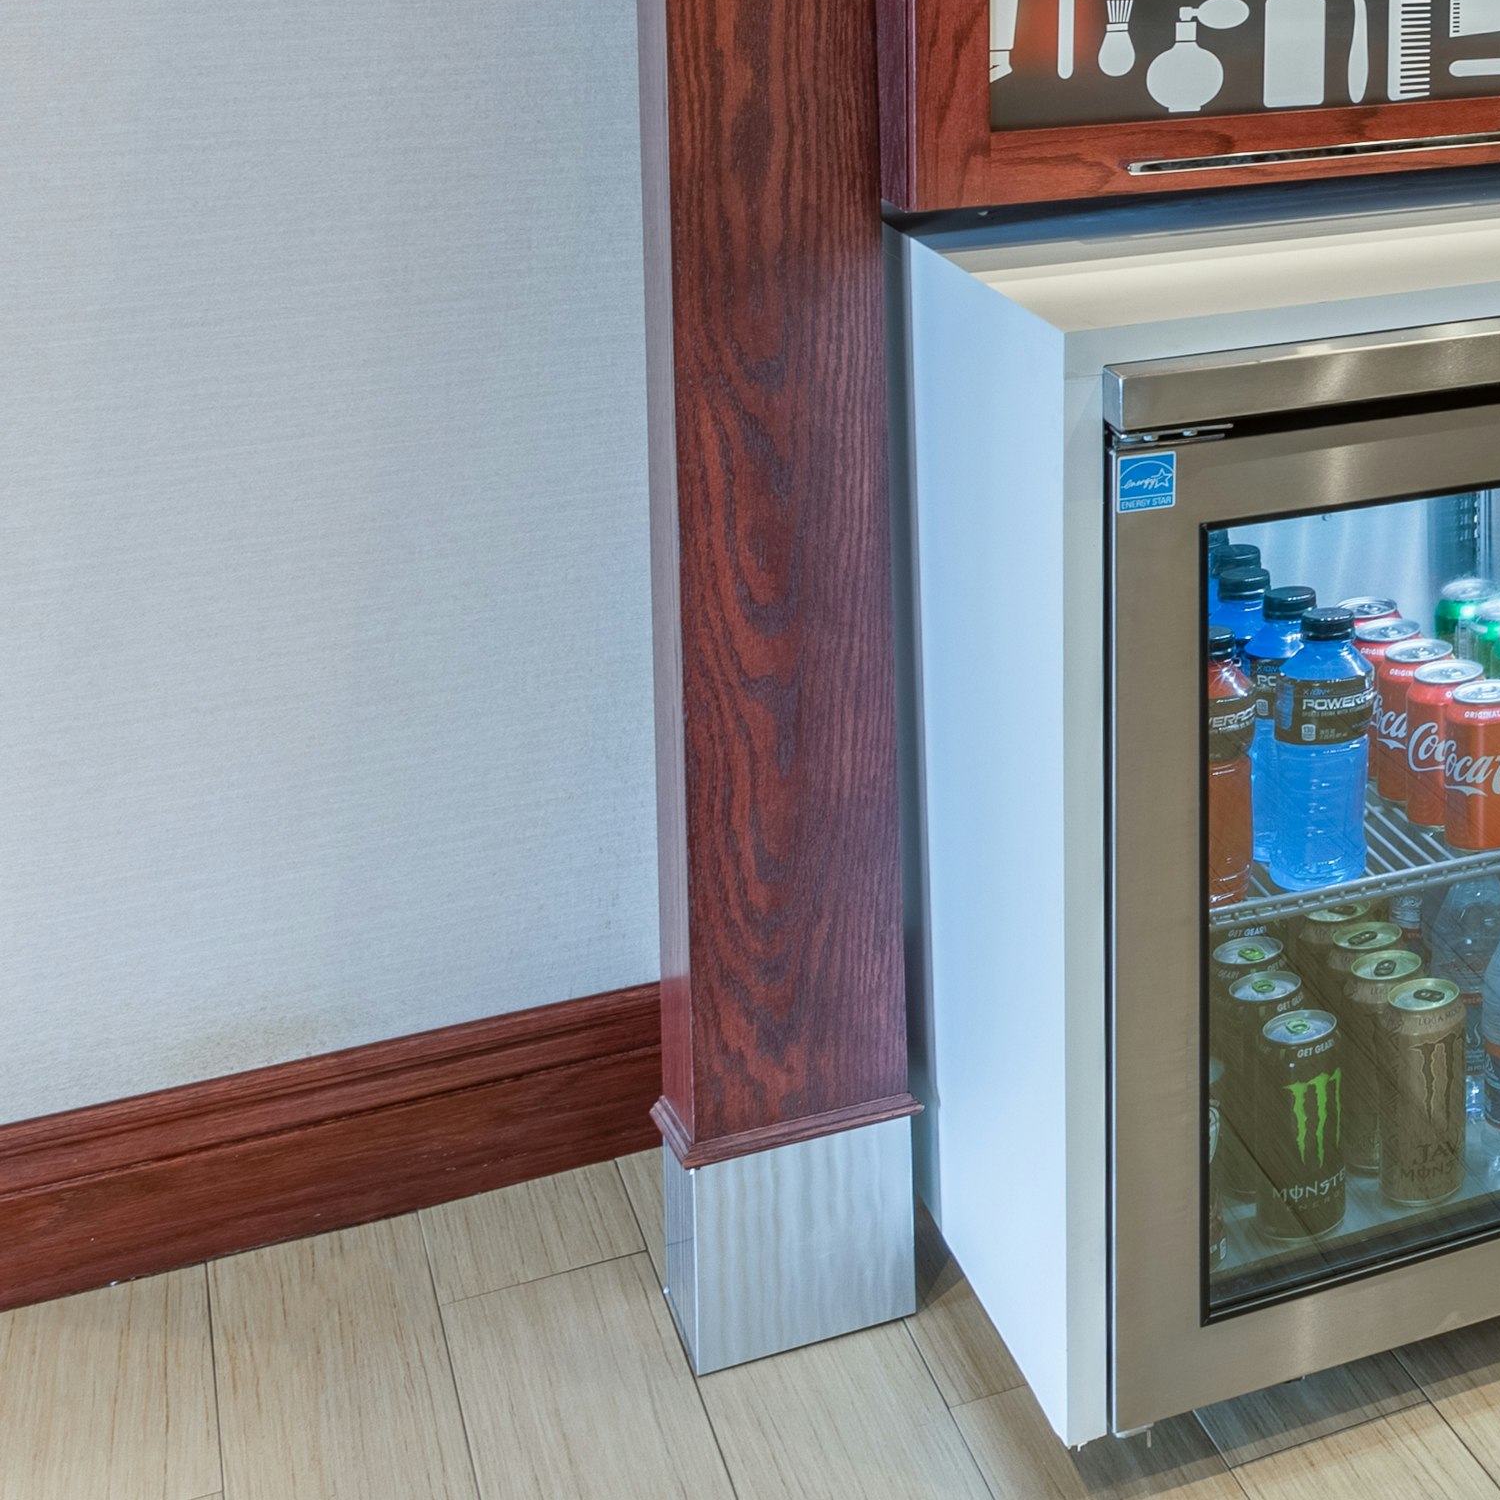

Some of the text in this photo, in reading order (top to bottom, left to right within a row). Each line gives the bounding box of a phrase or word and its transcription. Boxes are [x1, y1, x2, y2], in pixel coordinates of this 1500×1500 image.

[1121, 495, 1172, 510] ENERGY STAR
[1464, 707, 1500, 719] ORIGINAL
[1227, 928, 1243, 938] GET
[1297, 1047, 1313, 1059] GET
